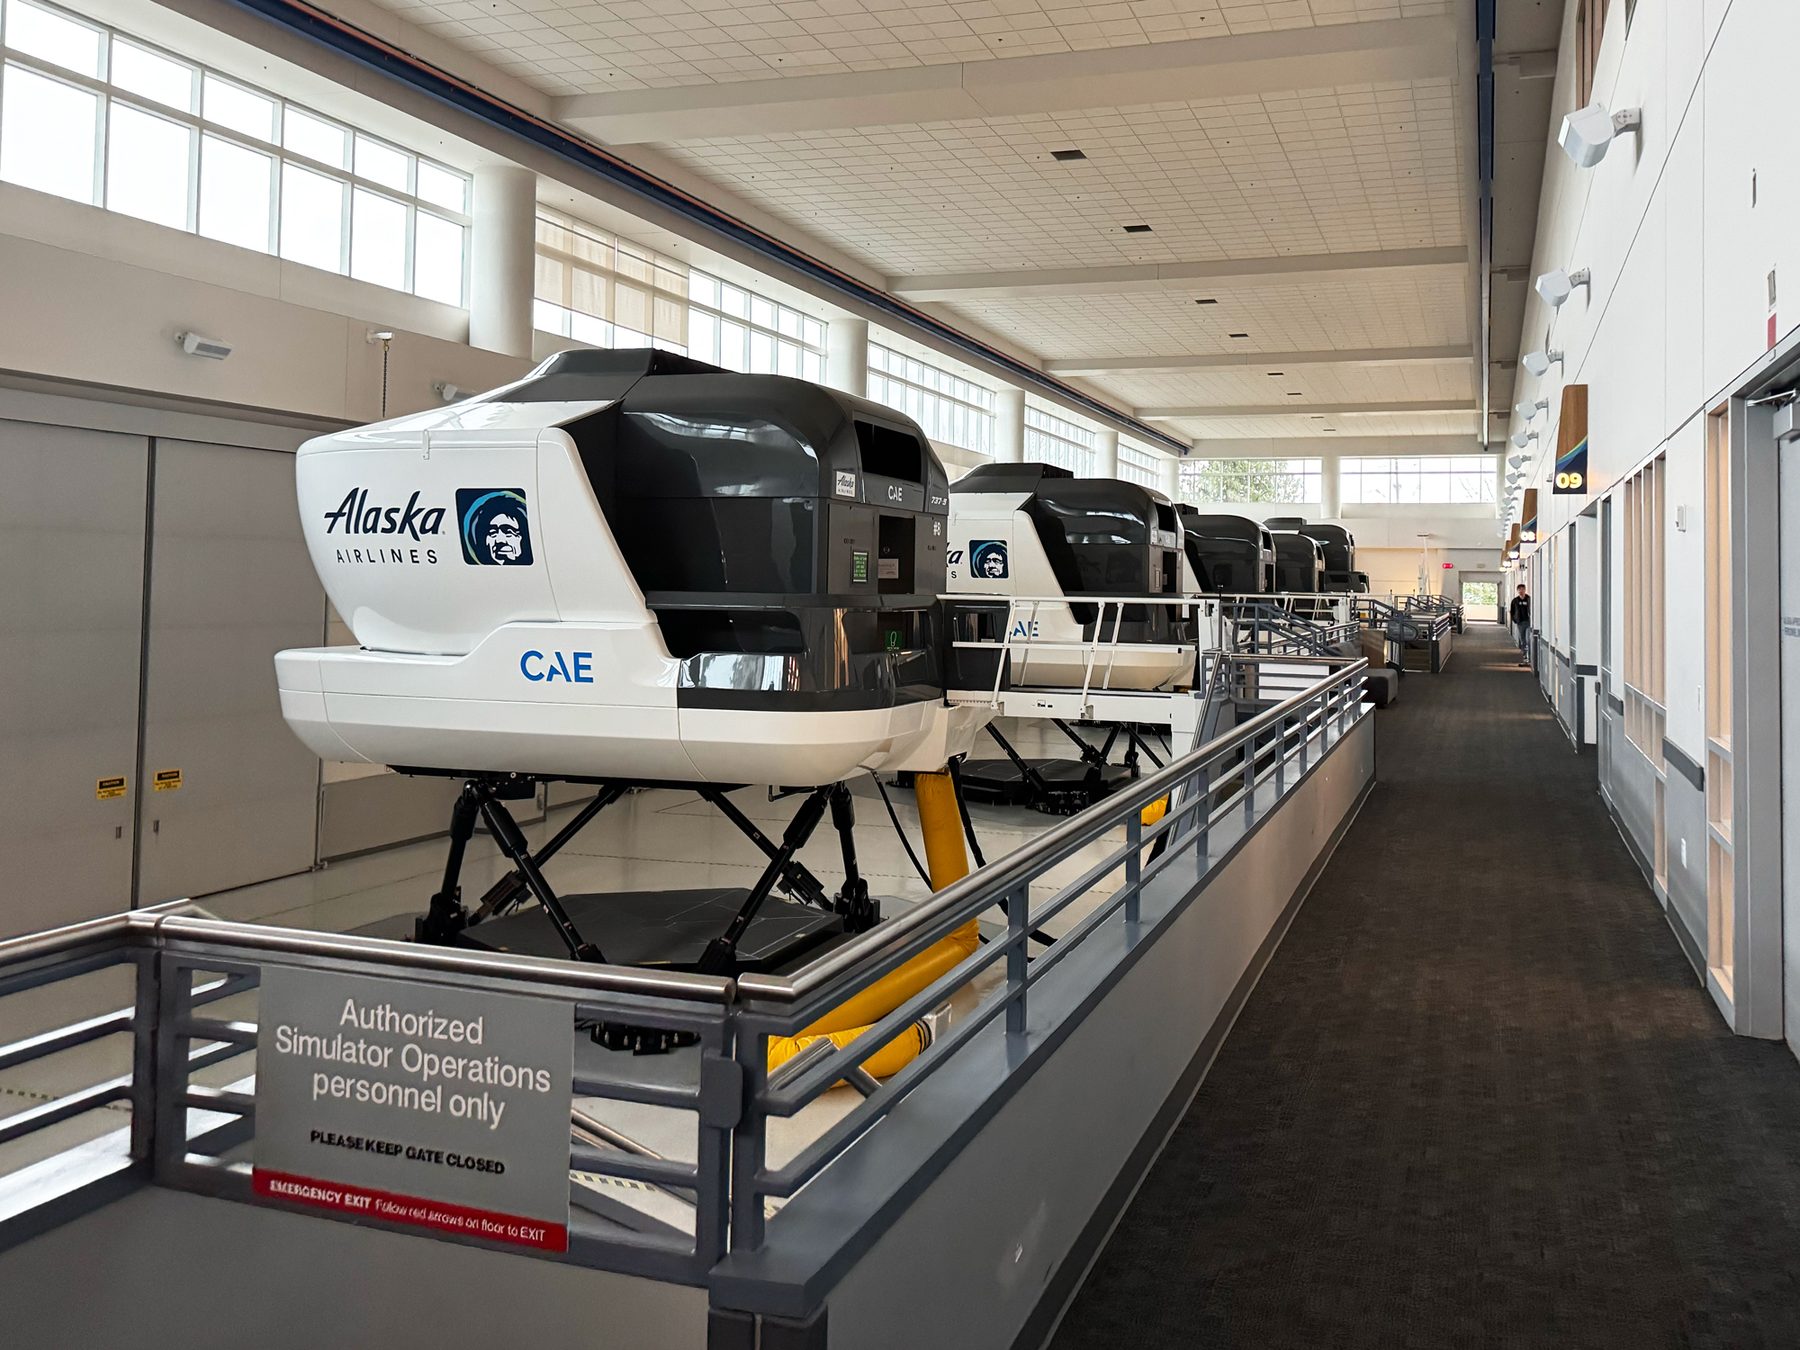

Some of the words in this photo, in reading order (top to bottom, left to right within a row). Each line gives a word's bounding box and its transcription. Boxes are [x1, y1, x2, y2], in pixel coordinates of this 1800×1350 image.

[888, 485, 903, 501] CAE
[1556, 472, 1582, 489] 09
[324, 487, 446, 542] Alaska
[336, 549, 438, 565] AIRLINES
[1013, 621, 1039, 637] AE
[520, 650, 594, 683] CAE
[340, 998, 483, 1044] Authorized
[276, 1025, 393, 1069] Simulator
[401, 1043, 552, 1093] Operations
[312, 1071, 441, 1114] personnel
[449, 1092, 506, 1130] only
[310, 1130, 365, 1151] PLEASE
[365, 1138, 403, 1156] KEEP
[405, 1146, 443, 1164] GATE
[446, 1154, 505, 1174] CLOSED
[269, 1180, 342, 1204] EMERGENCY
[344, 1193, 372, 1210] EXIT
[408, 1206, 428, 1220] red
[428, 1209, 463, 1227] arrows
[465, 1216, 480, 1229] on
[480, 1217, 506, 1235] floor
[507, 1223, 519, 1237] to
[519, 1227, 546, 1242] EXIT
